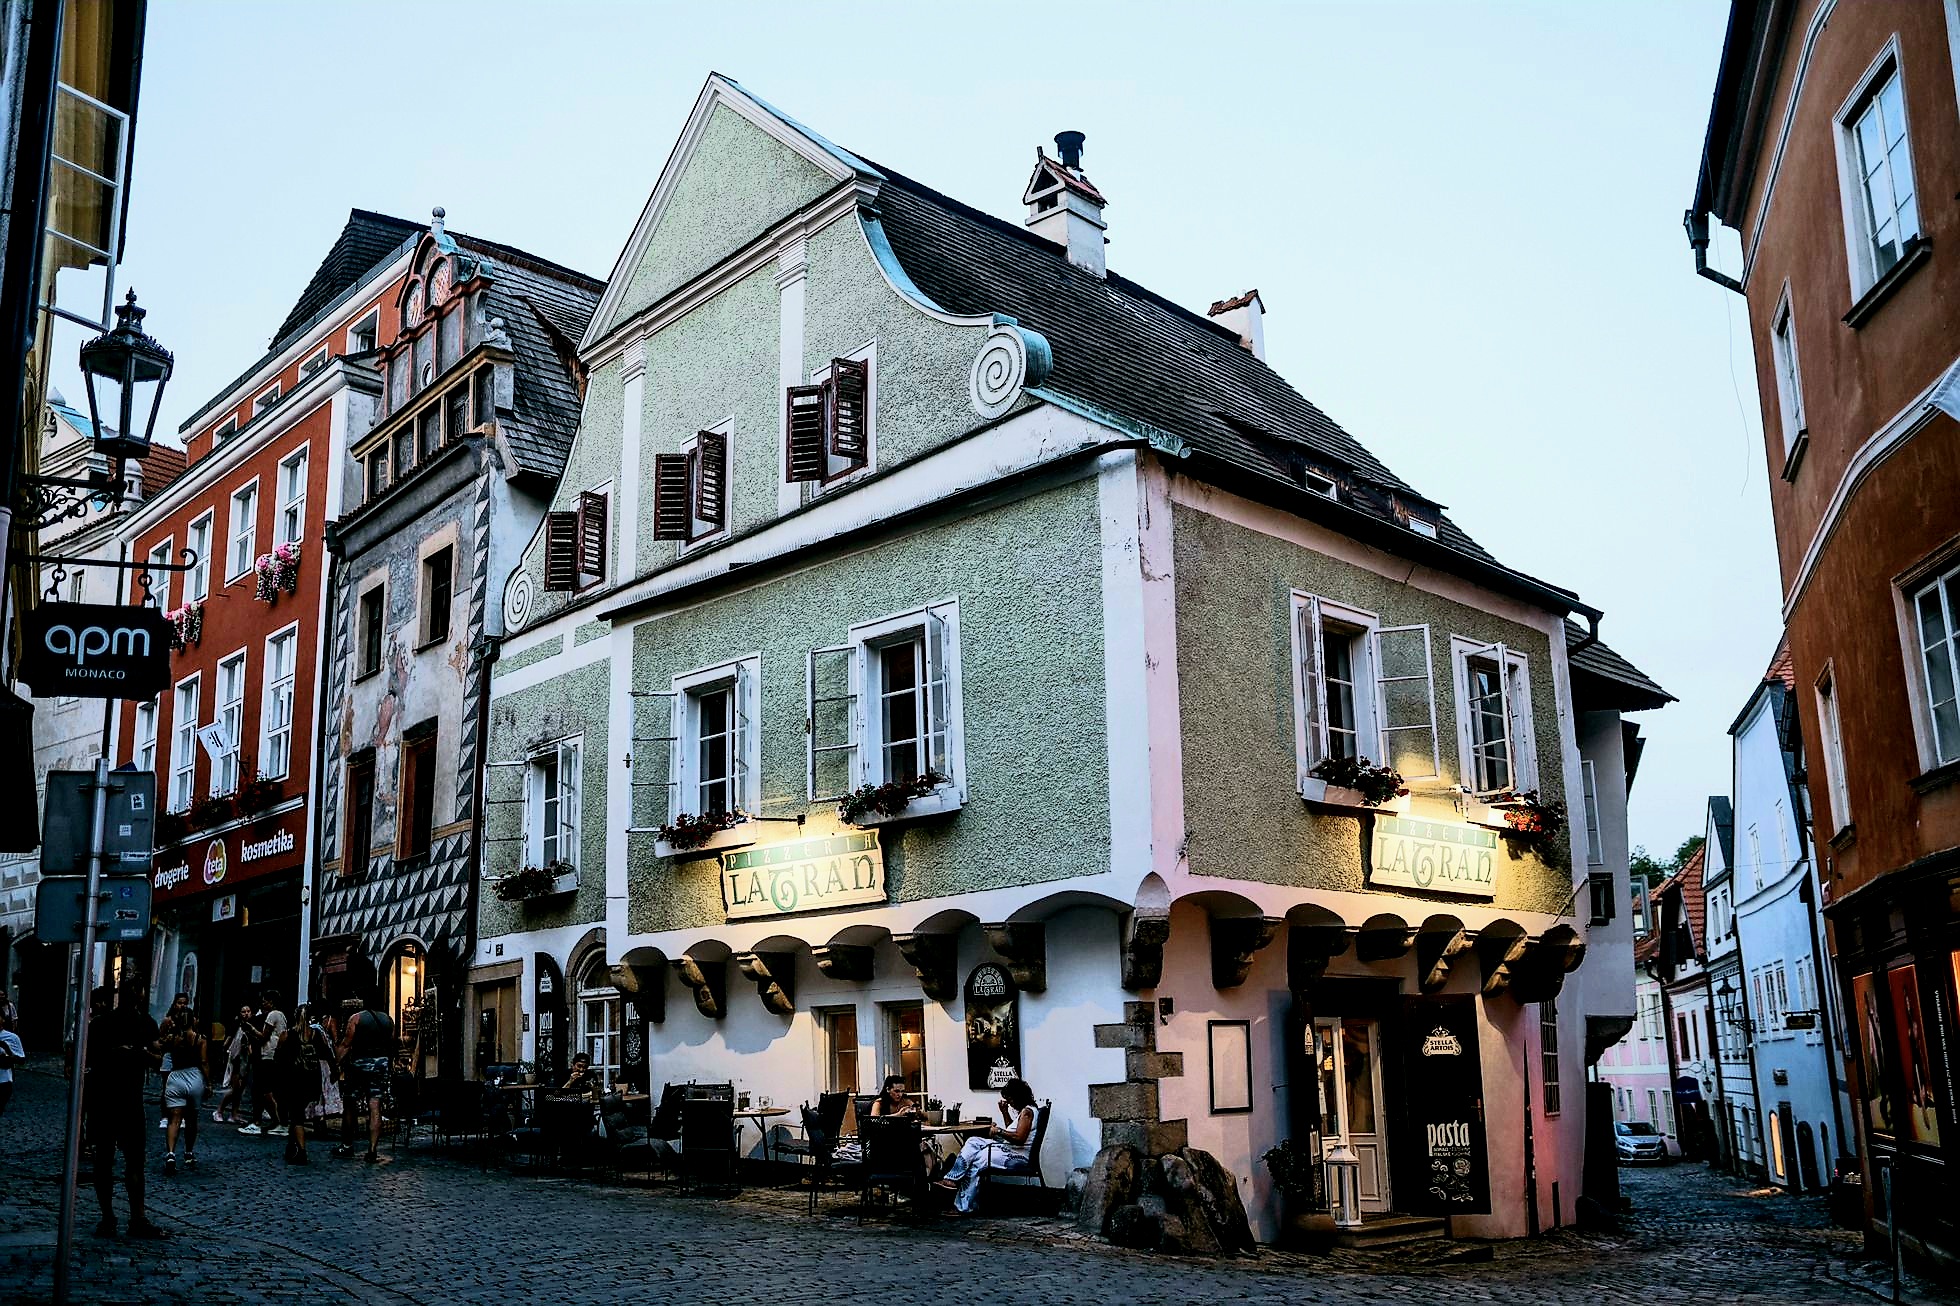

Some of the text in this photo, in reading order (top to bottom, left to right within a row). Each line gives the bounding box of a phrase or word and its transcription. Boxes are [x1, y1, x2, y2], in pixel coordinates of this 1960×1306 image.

[45, 625, 150, 665] apm
[65, 668, 126, 680] MONACO
[729, 833, 873, 869] PIZZERIA
[1381, 818, 1493, 847] PIZZERIA
[154, 828, 294, 890] drogerie teta kosmetika
[1426, 1119, 1471, 1157] pasta
